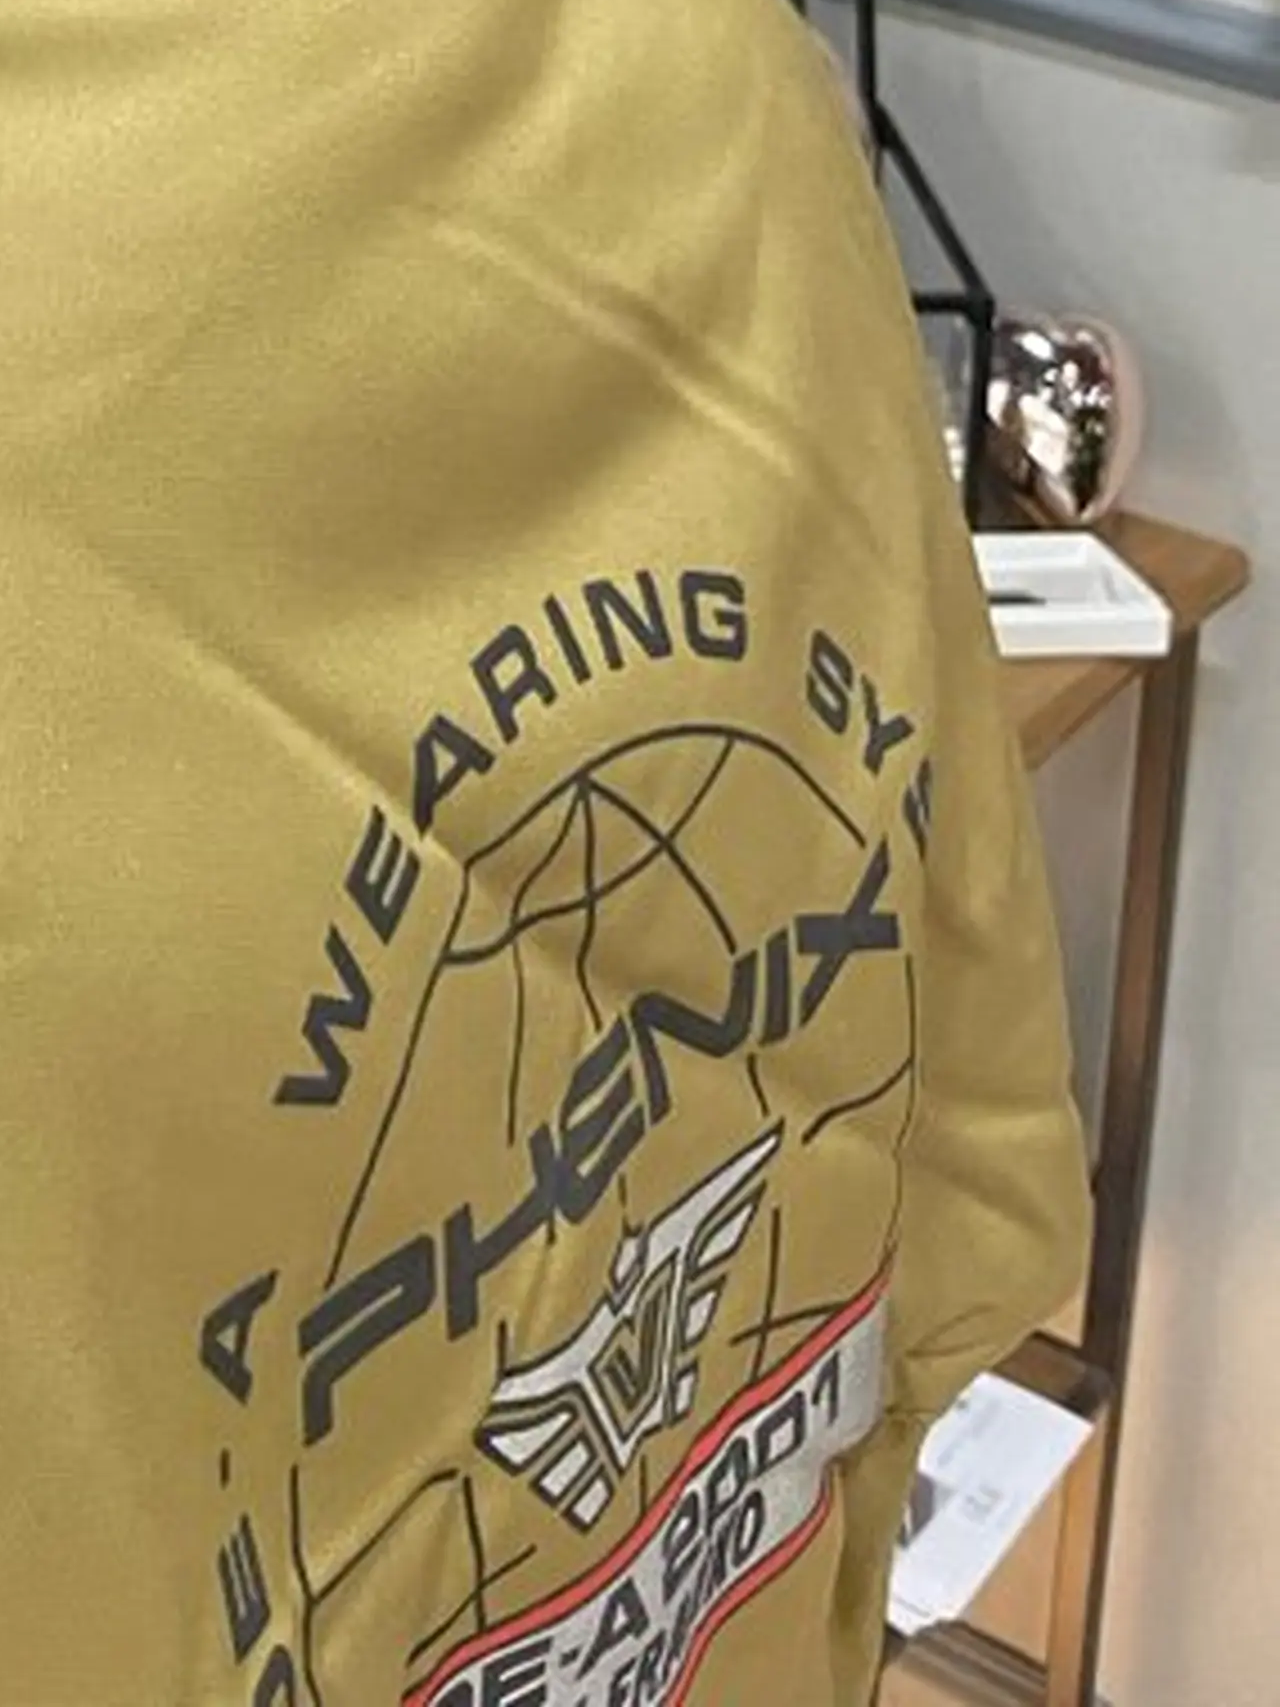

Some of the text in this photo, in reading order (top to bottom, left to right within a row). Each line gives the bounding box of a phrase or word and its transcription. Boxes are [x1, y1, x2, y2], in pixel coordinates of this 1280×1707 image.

[272, 569, 748, 1107] WEARING
[297, 837, 901, 1446] PHENIX
[662, 1350, 840, 1603] 2001
